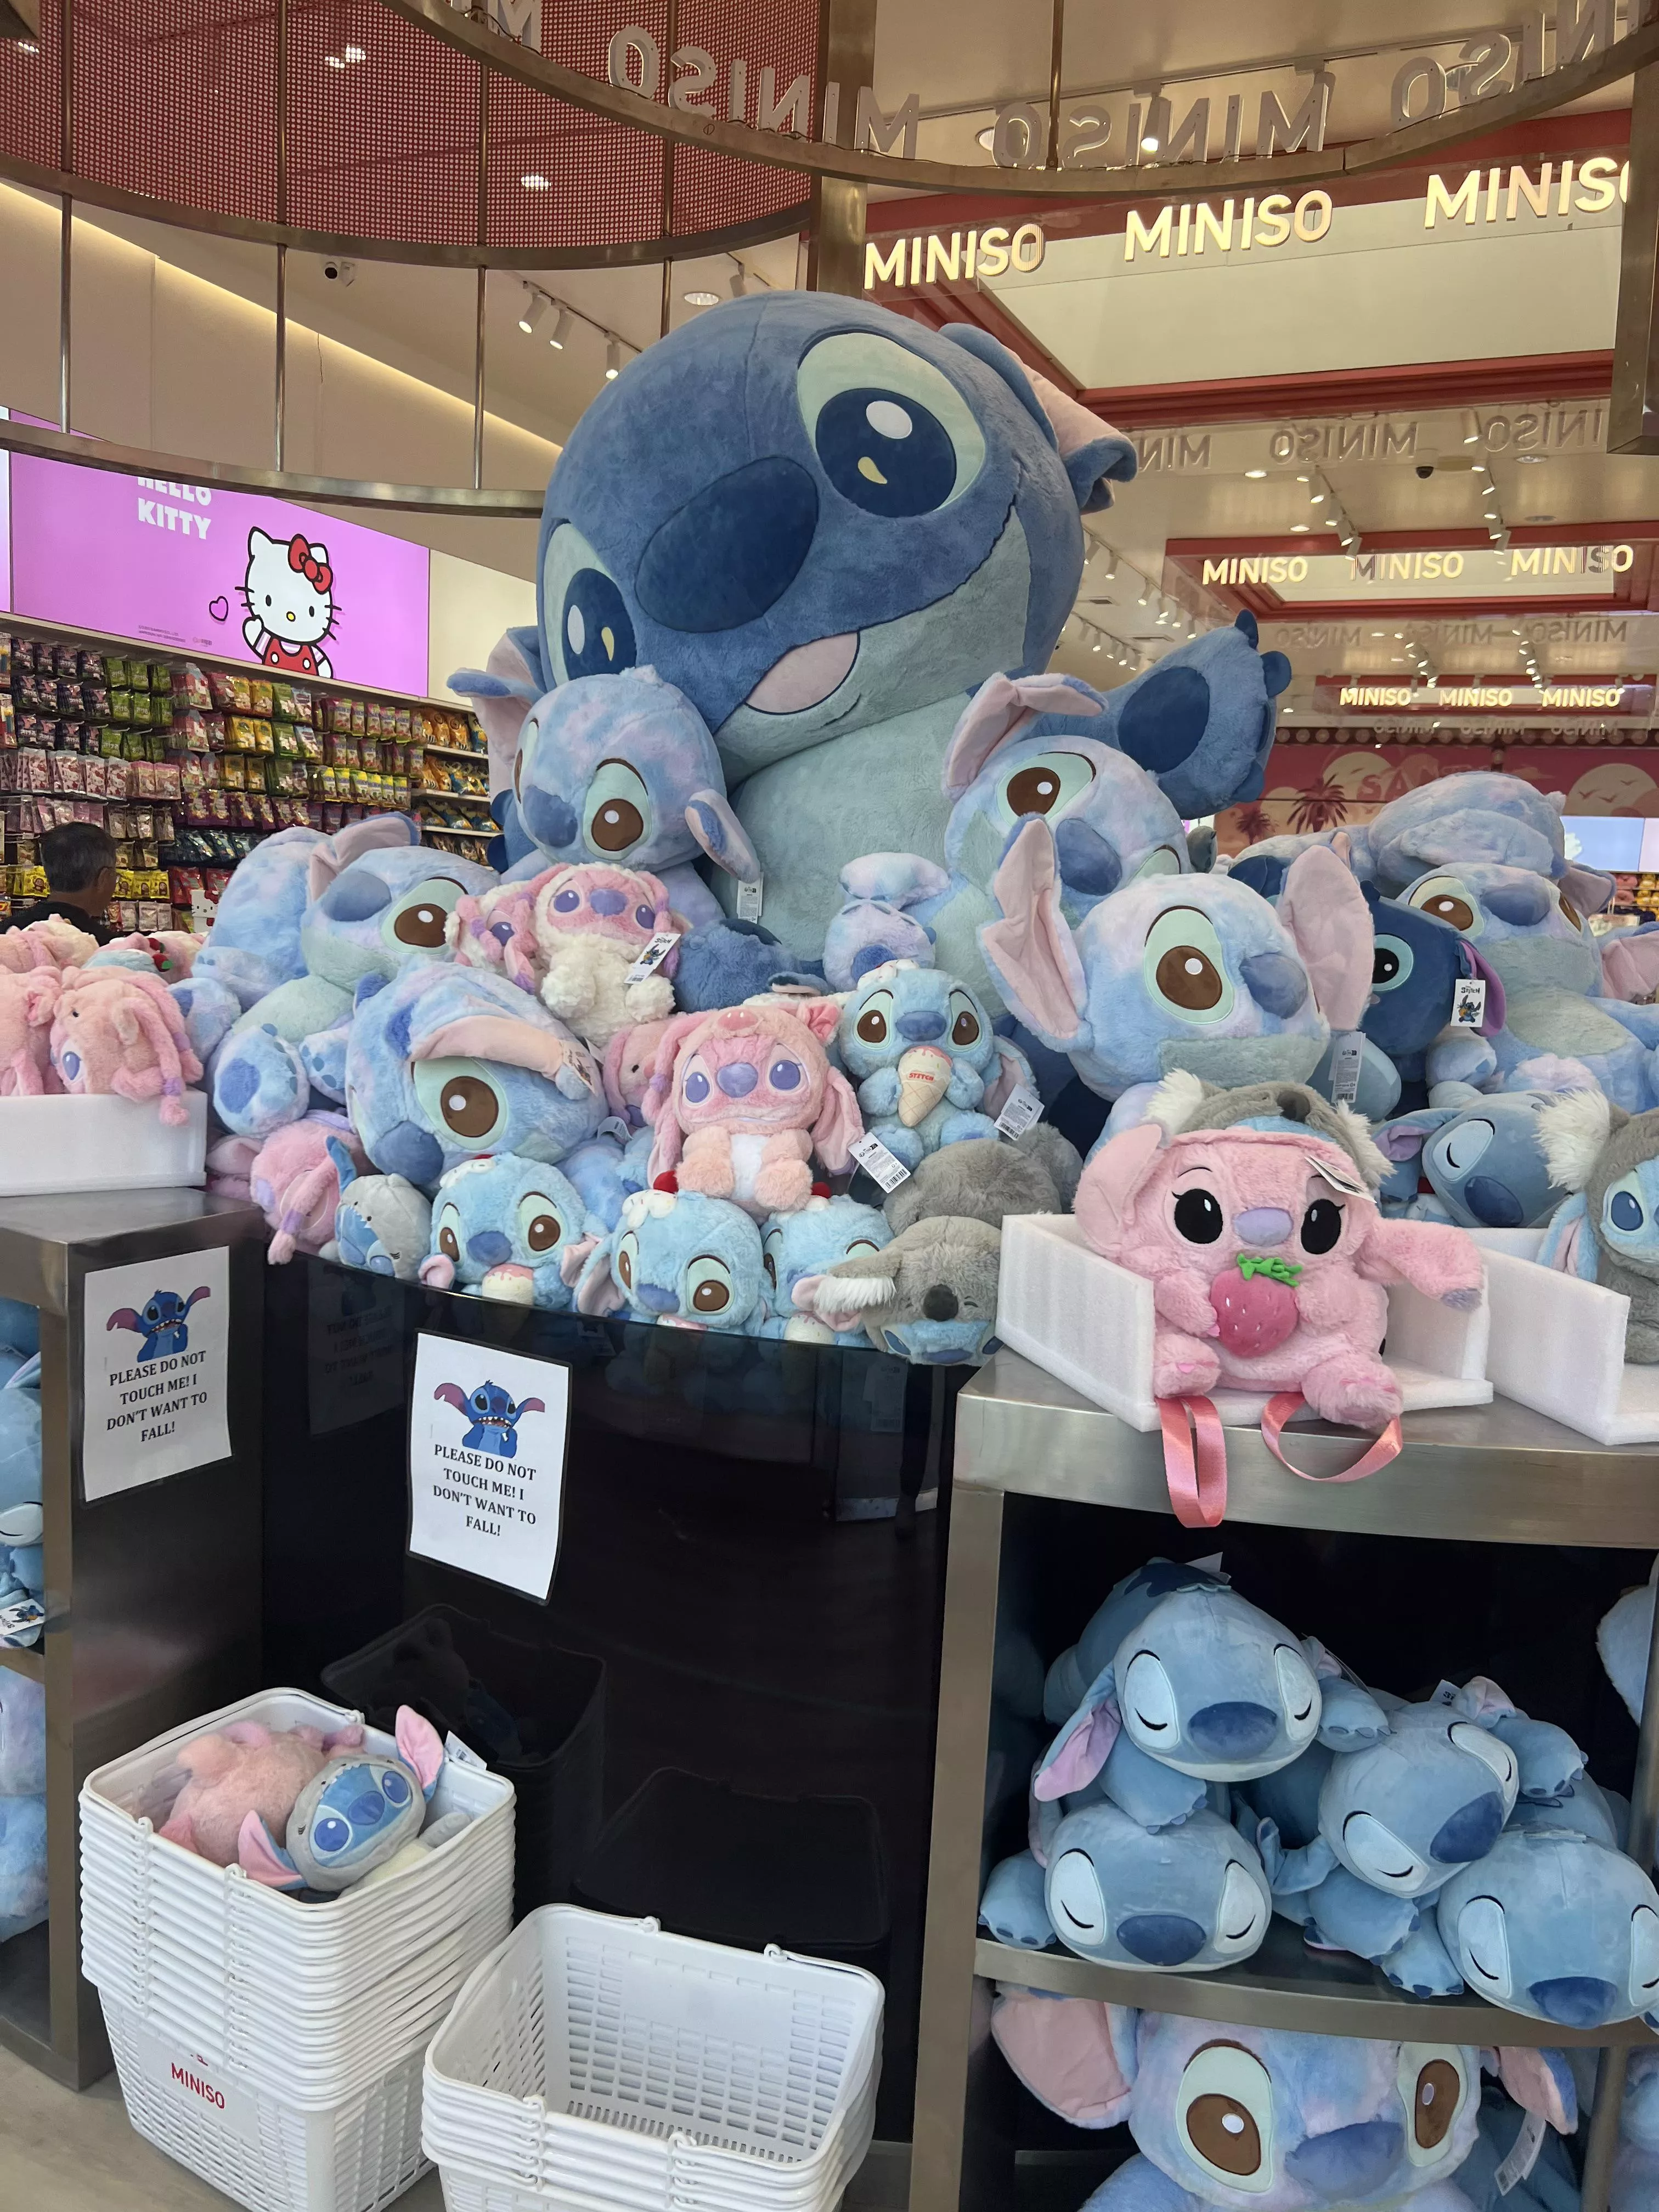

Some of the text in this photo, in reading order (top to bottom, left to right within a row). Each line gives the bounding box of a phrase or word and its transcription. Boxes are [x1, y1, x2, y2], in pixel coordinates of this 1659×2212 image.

[864, 223, 1045, 290] MINISO
[1124, 189, 1333, 262] MINISO
[138, 497, 212, 540] KITTY
[1202, 544, 1634, 585] MINISO MINISO MINISO
[1339, 687, 1621, 708] MINISO MINISO MINISO
[909, 1072, 934, 1081] STITCH
[110, 1350, 206, 1386] PLEASE DO NOT
[120, 1373, 198, 1405] TOUCH ME! I
[106, 1391, 208, 1431] DON'T WANT TO
[140, 1421, 175, 1442] FALL!
[434, 1443, 537, 1481] PLEASE DO NOT
[443, 1468, 524, 1501] TOUCH ME! I
[433, 1485, 537, 1525] DON'T WANT TO
[466, 1515, 501, 1537] FALL!
[171, 2062, 225, 2109] MINISO
